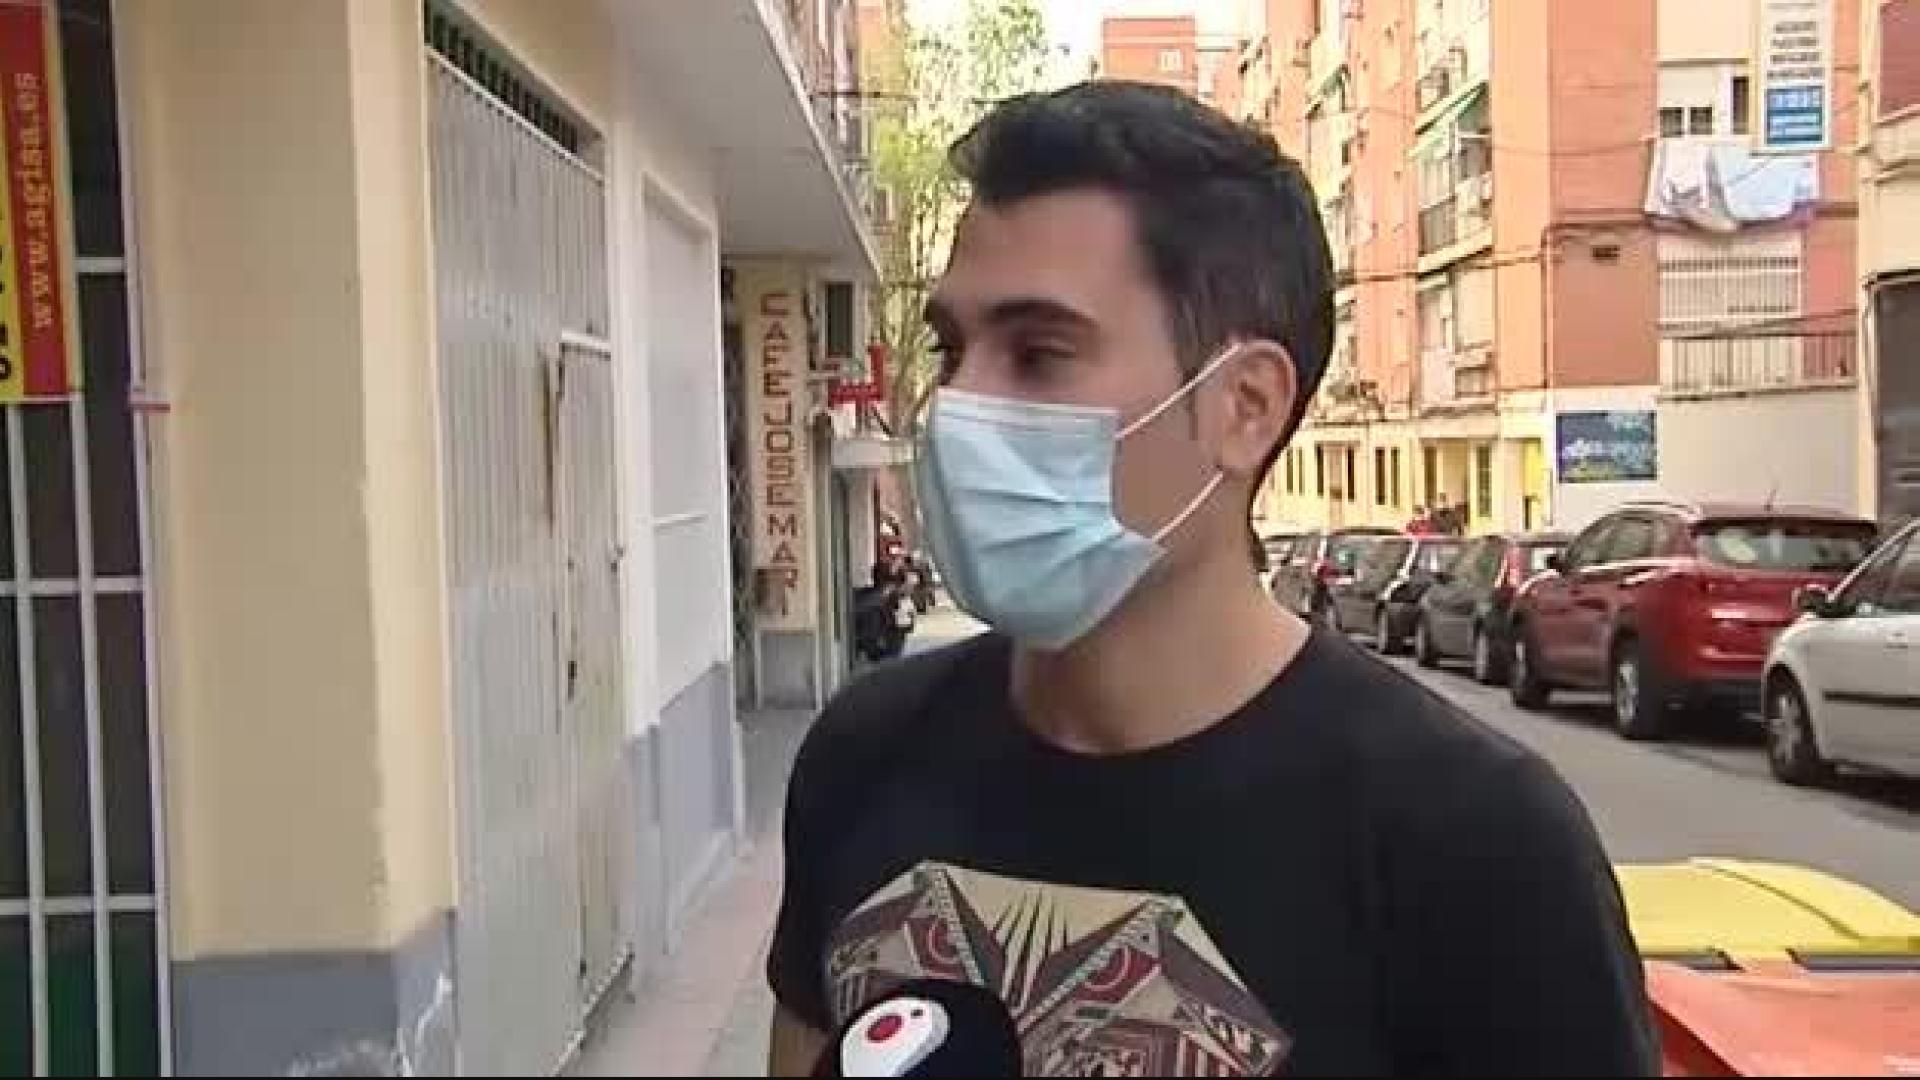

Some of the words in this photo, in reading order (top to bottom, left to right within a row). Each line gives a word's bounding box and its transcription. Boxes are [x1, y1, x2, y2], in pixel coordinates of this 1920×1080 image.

[14, 72, 53, 328] www.agisa.es
[760, 292, 792, 396] CAFE
[763, 399, 795, 507] JOSE
